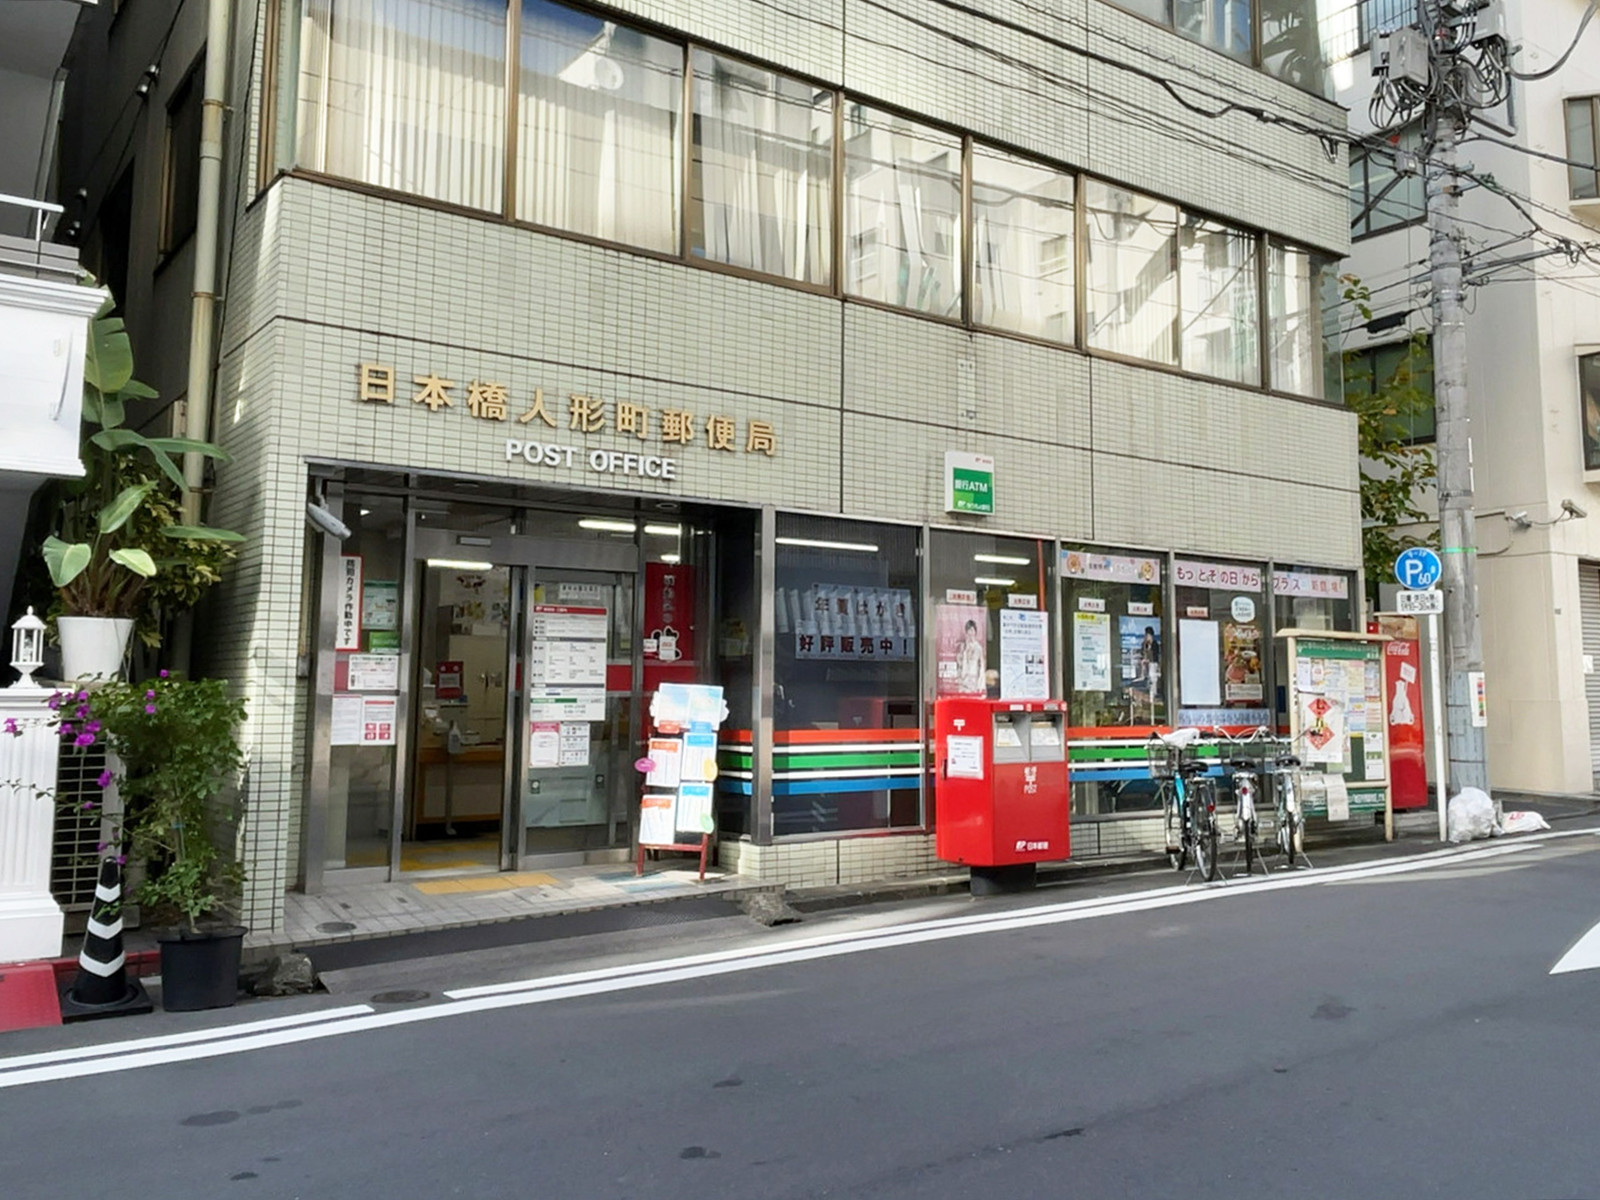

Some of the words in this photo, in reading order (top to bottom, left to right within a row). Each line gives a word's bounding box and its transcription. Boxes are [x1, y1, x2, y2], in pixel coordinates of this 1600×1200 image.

[358, 363, 778, 456] 日本橋人形町郵便局
[506, 439, 577, 468] POST
[589, 449, 677, 480] OFFICE
[1176, 566, 1259, 586] もっとその日から
[1404, 559, 1423, 585] P
[1418, 573, 1432, 585] 60
[815, 597, 906, 618] 年賀はがき
[799, 635, 907, 656] 好評販売中！
